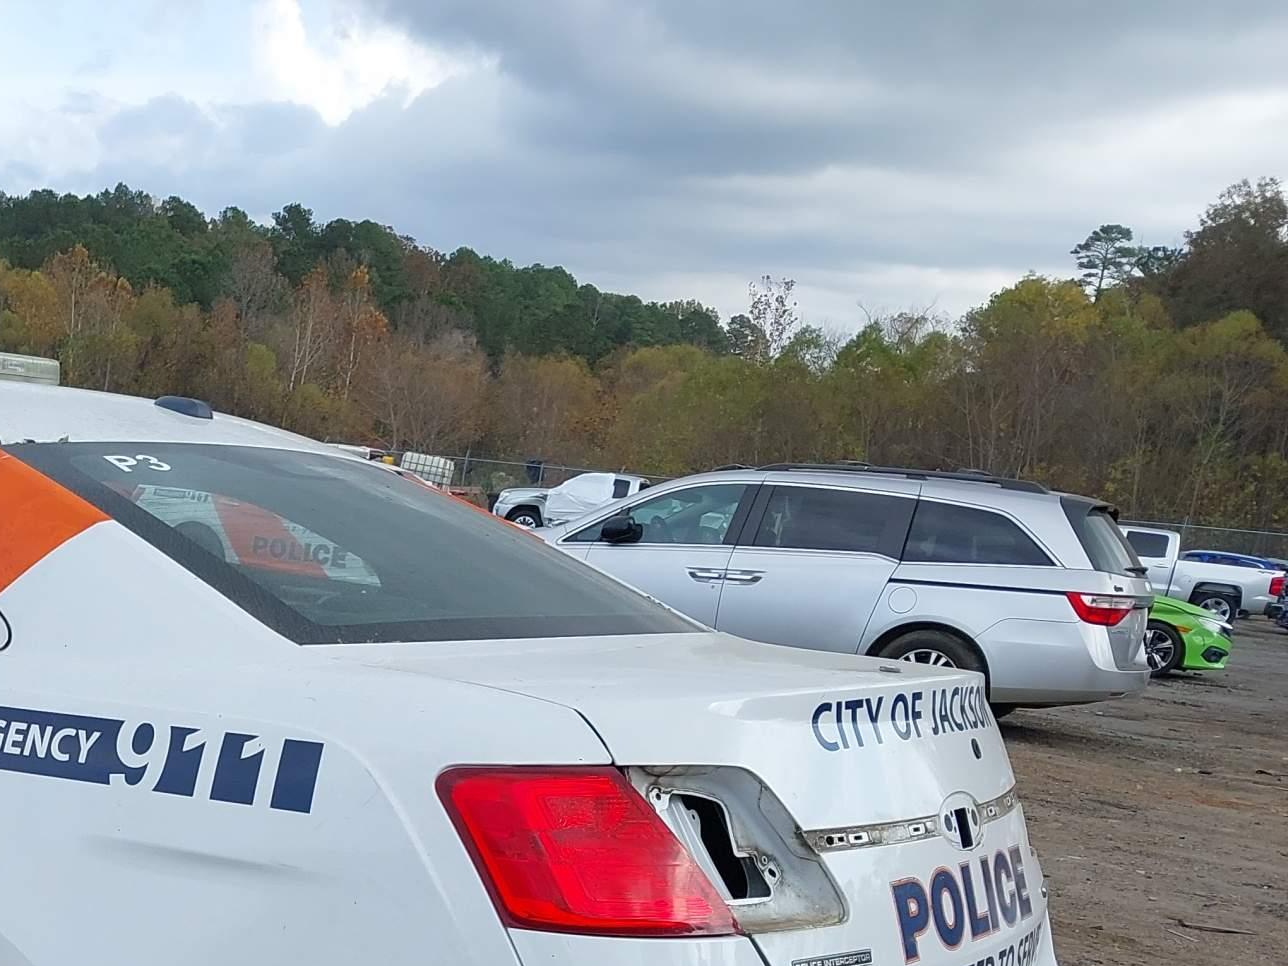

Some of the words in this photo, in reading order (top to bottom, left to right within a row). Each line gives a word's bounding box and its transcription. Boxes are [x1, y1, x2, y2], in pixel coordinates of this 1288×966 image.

[102, 454, 171, 472] P3
[812, 696, 885, 752] CITY
[890, 691, 923, 741] OF
[931, 686, 993, 736] JACKSON
[890, 843, 1033, 965] POLICE
